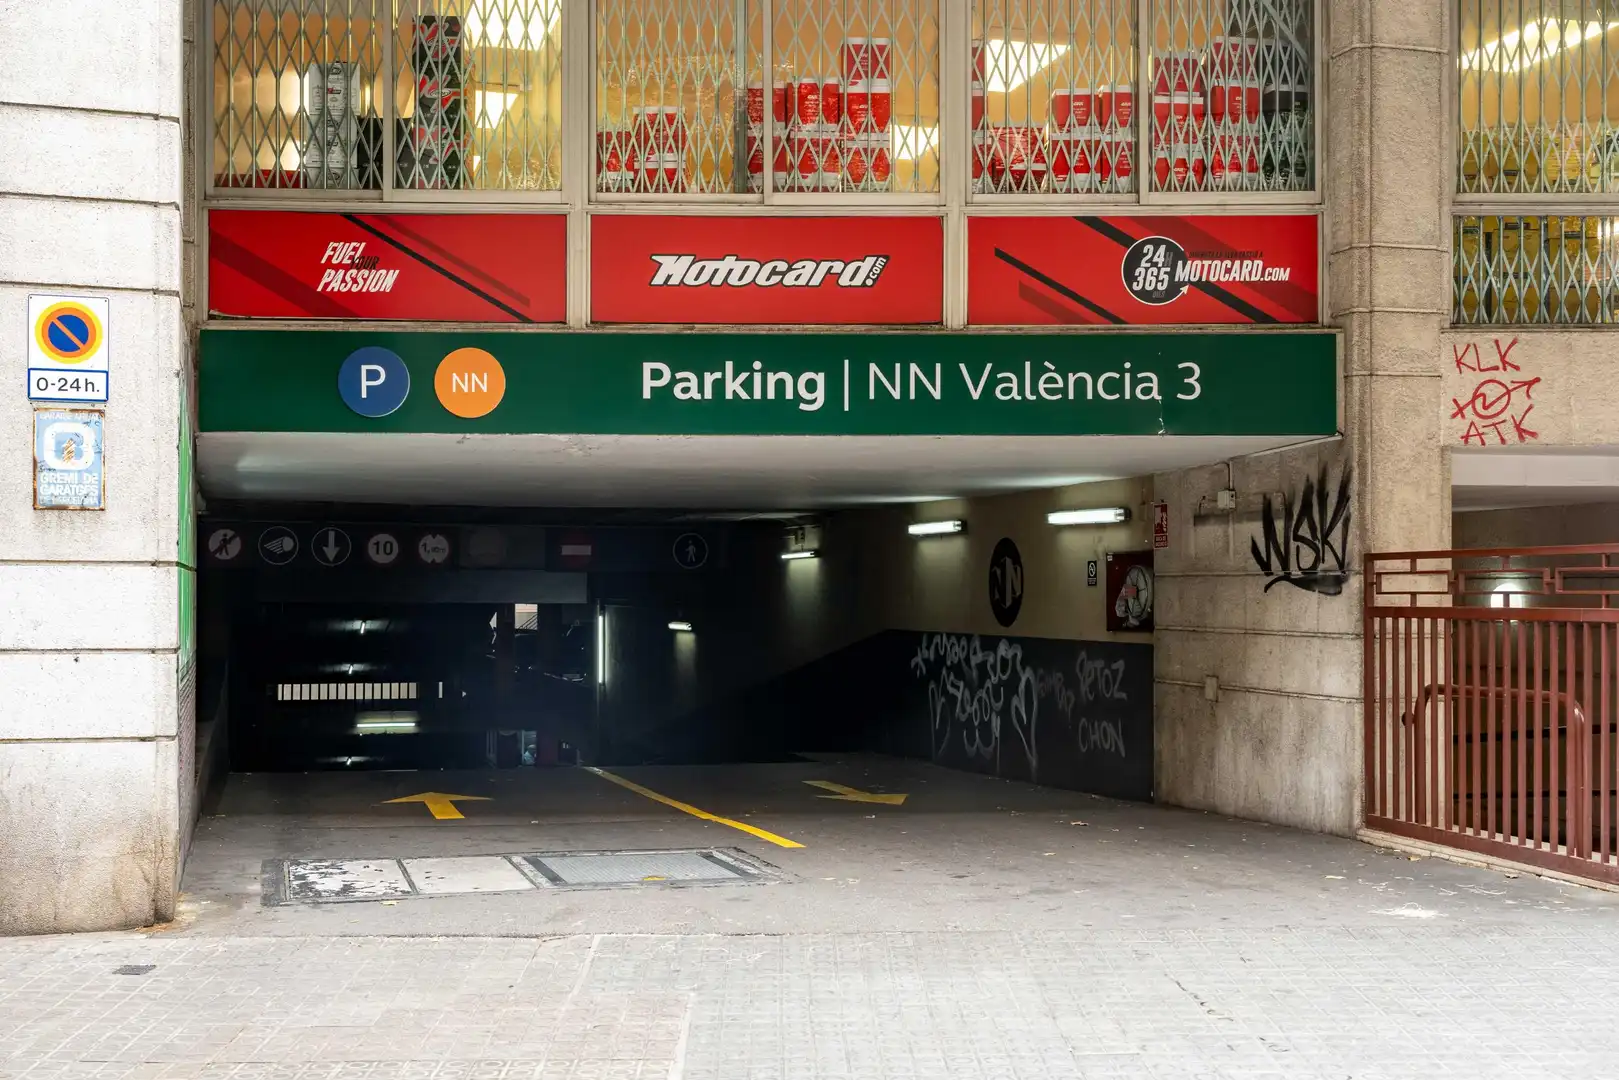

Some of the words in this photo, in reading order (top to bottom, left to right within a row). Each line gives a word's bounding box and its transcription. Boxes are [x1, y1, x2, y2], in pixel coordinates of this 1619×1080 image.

[320, 241, 367, 264] FUEL
[316, 268, 400, 293] PASSION
[1132, 267, 1171, 291] 365
[1173, 259, 1291, 283] MOTOCARD.COM
[1453, 336, 1521, 375] KLK
[360, 364, 386, 399] P
[452, 372, 488, 393] NN
[641, 360, 826, 411] Parking
[868, 362, 943, 401] NN
[960, 359, 1161, 401] València
[1176, 362, 1202, 401] 3
[1460, 404, 1539, 447] ATK
[40, 472, 79, 484] GREMI
[373, 540, 394, 556] 10
